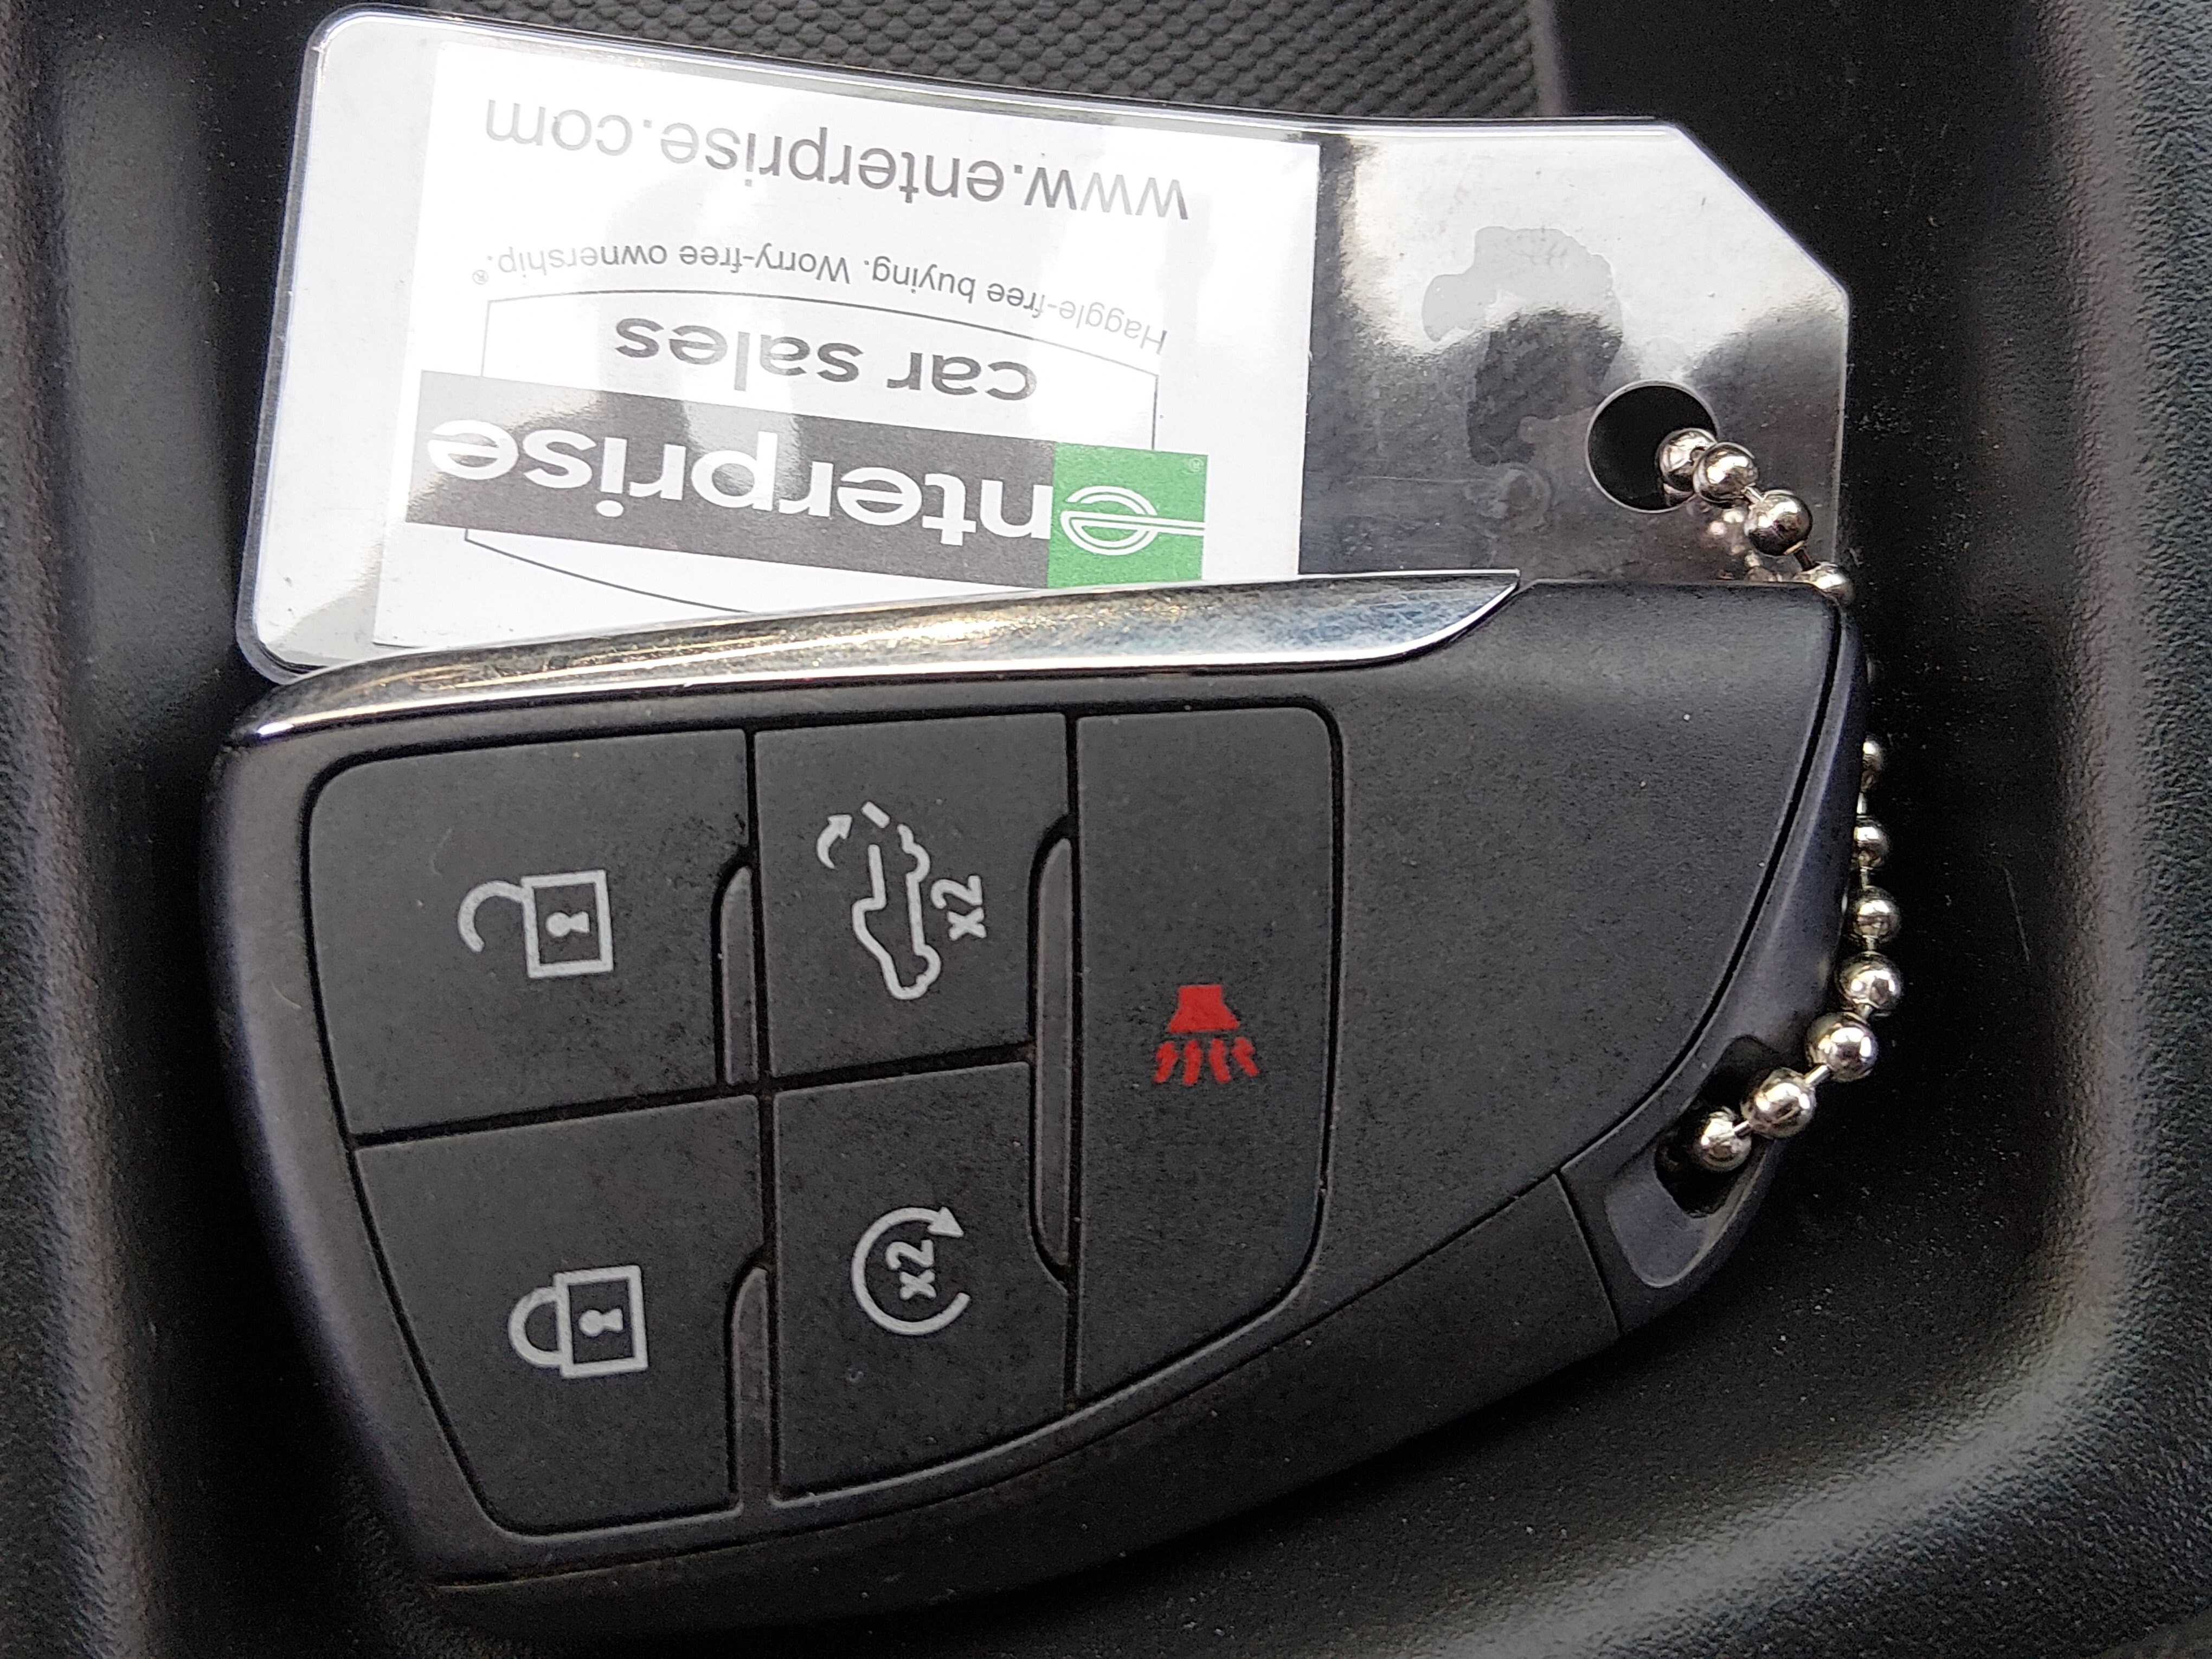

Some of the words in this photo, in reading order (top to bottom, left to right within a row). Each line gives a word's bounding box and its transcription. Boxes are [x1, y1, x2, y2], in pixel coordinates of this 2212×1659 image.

[486, 98, 1188, 220] www.enterprise.com
[678, 242, 850, 284] Worry-free
[863, 255, 976, 304] buying.
[986, 282, 1167, 355] Haggle-free
[613, 317, 864, 391] sales
[885, 351, 1037, 401] car
[426, 417, 1205, 556] enterprise
[930, 874, 987, 941] x2
[885, 1239, 937, 1301] x2
